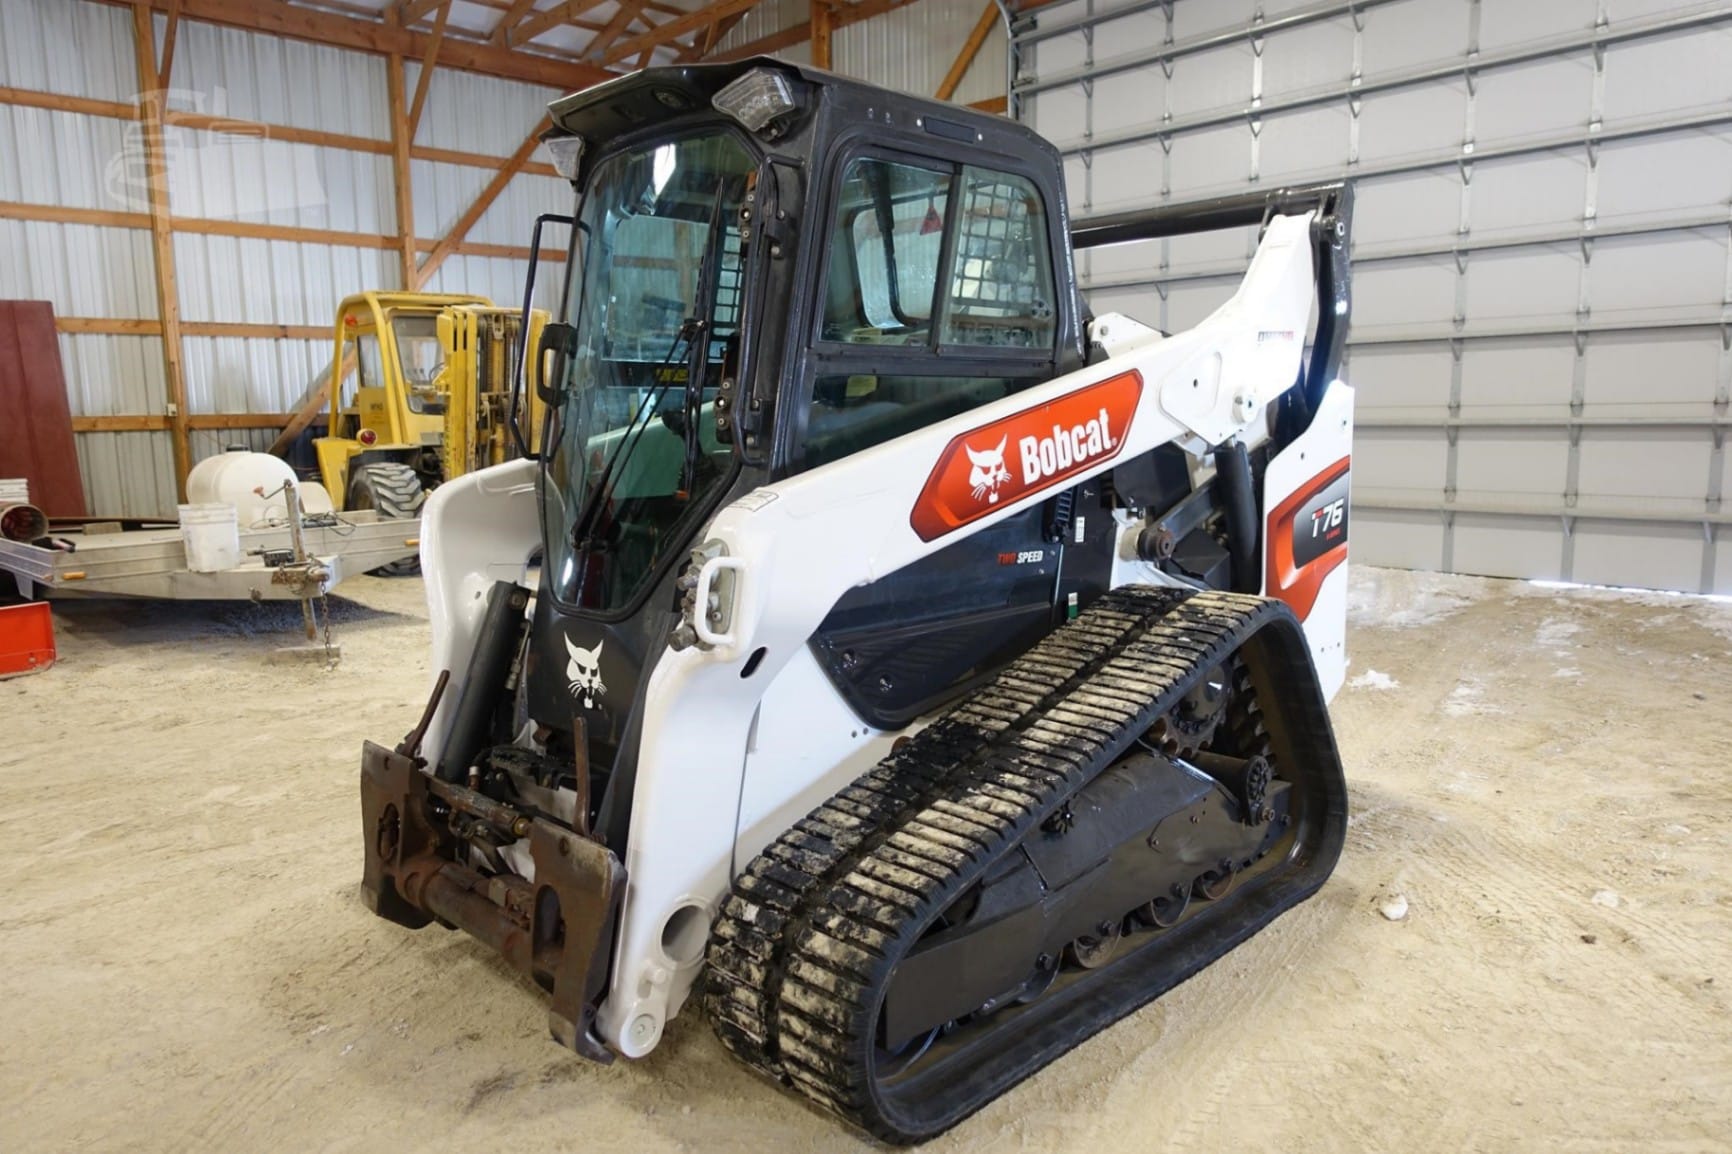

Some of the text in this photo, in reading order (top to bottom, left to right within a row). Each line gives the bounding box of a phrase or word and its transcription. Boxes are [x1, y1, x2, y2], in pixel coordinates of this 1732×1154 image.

[1018, 407, 1112, 486] Bobcat
[1311, 497, 1345, 538] T76
[1017, 550, 1044, 564] SPEED
